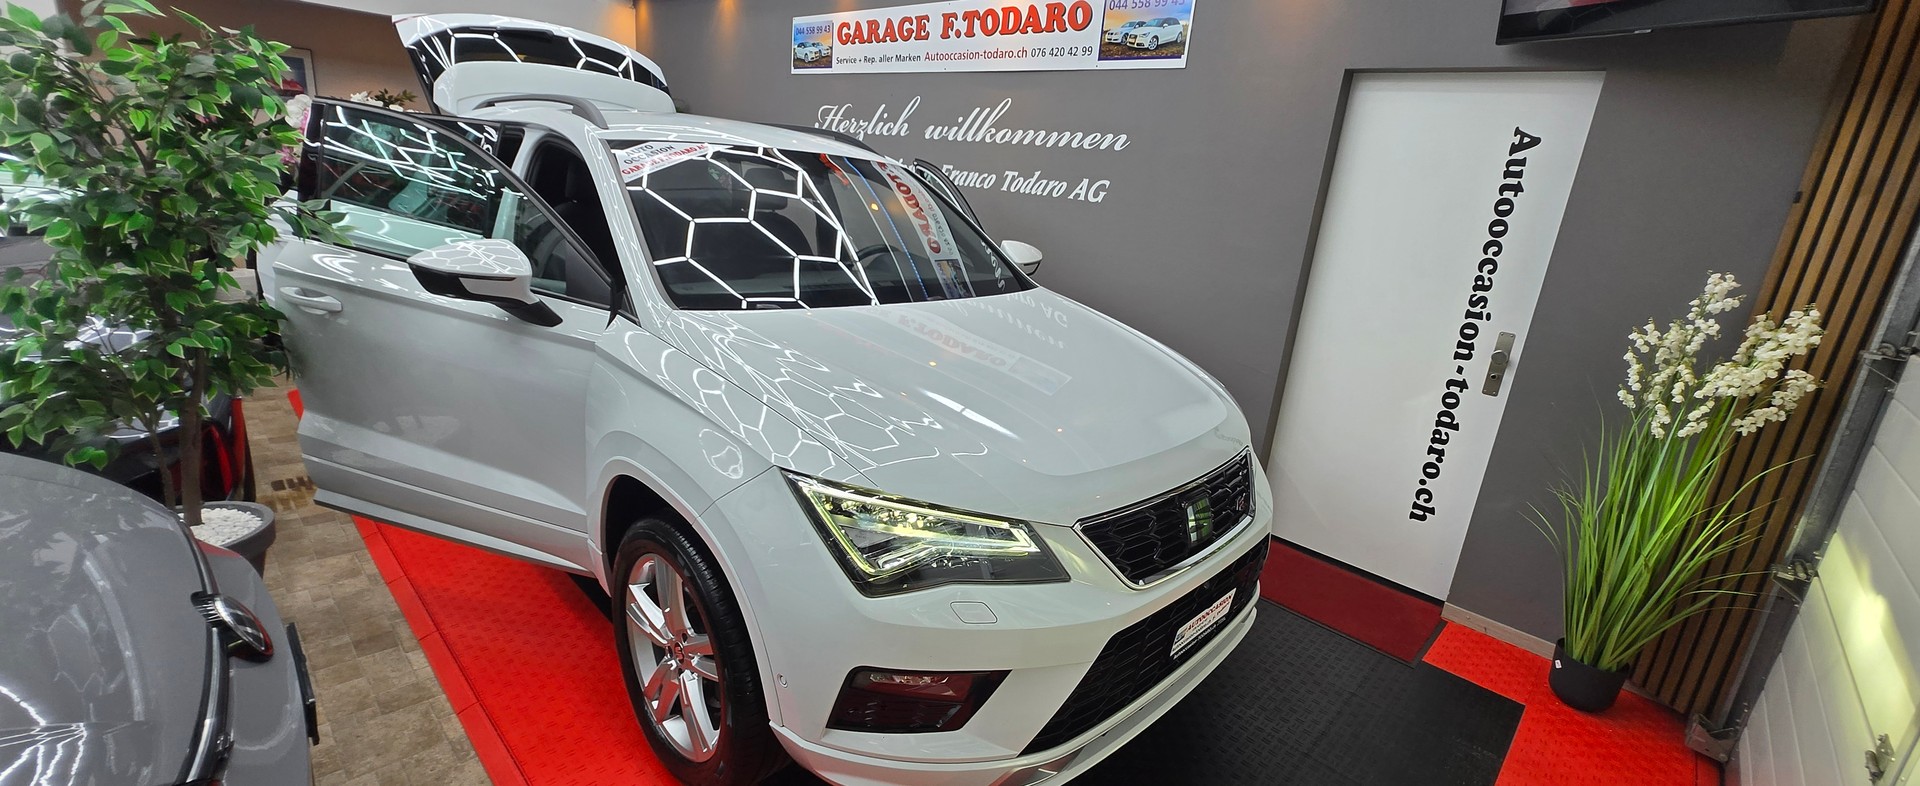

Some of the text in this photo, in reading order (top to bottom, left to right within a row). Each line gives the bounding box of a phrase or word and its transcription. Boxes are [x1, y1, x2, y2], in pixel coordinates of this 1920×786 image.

[1109, 0, 1128, 10] 044
[1131, 0, 1151, 9] 558
[824, 24, 831, 33] 43
[836, 0, 1093, 46] GARAGE F.TODARO
[835, 55, 857, 65] Service
[863, 55, 877, 65] Rep.
[878, 53, 894, 63] aller
[895, 53, 921, 63] Marken
[924, 47, 1028, 62] Autooccasion-todaro.ch
[1030, 48, 1047, 59] 076
[1048, 48, 1065, 58] 420
[1066, 47, 1079, 57] 42
[1080, 46, 1093, 57] 99
[814, 96, 1131, 152] Herzlich willkommen
[625, 144, 654, 157] AUTO
[941, 163, 997, 190] Franco
[1002, 170, 1068, 198] Todaro
[1068, 177, 1111, 203] AG
[1408, 126, 1542, 523] Autooccasion-todaro.ch
